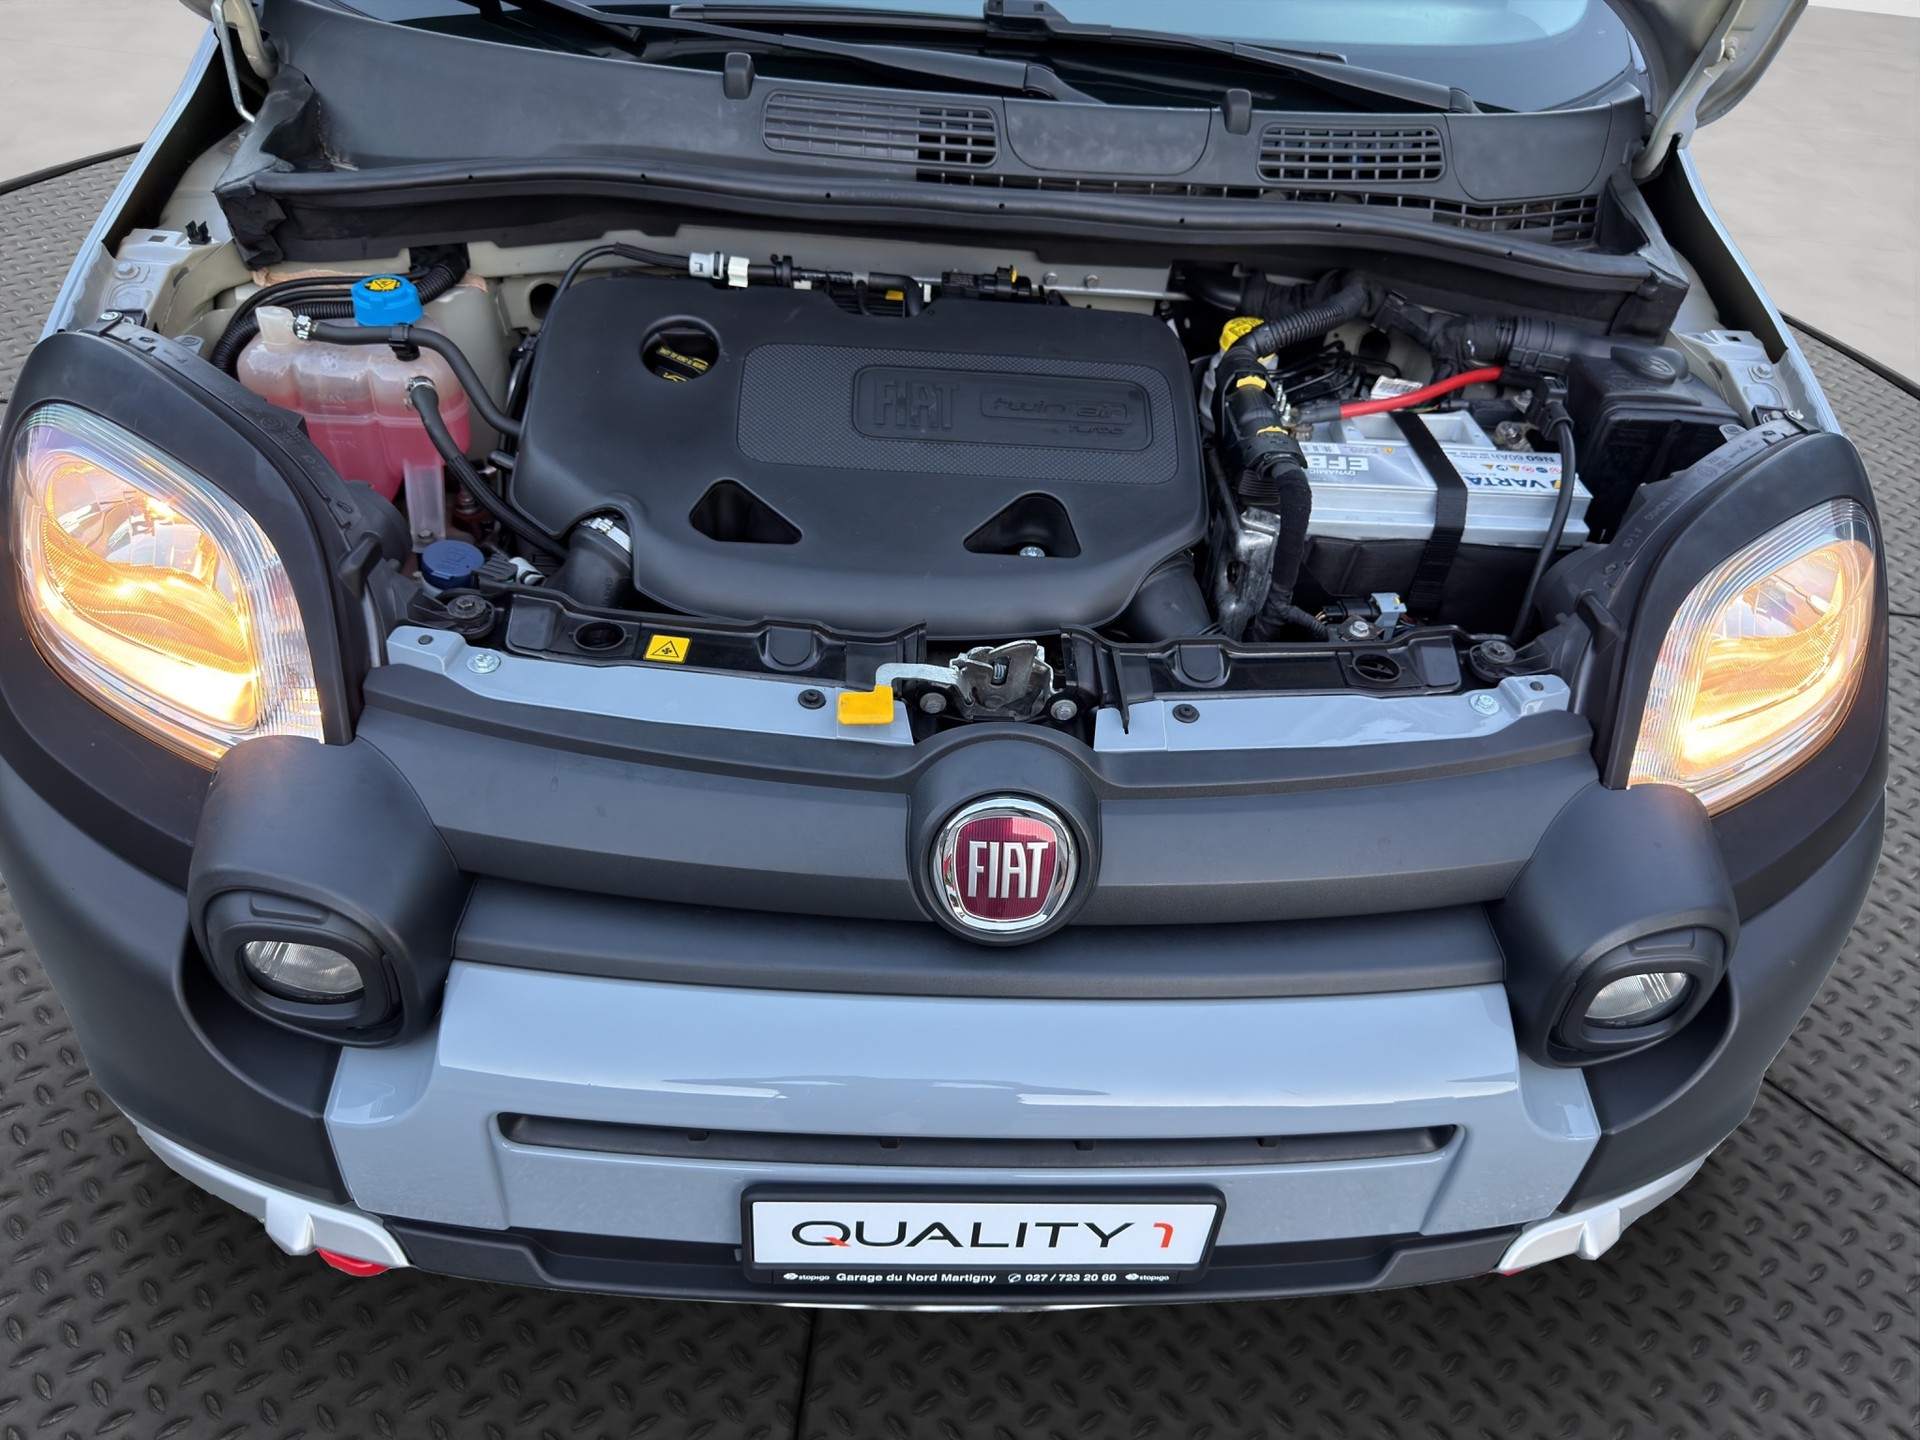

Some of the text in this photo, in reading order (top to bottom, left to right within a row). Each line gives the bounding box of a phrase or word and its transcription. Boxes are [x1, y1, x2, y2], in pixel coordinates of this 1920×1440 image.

[873, 379, 960, 429] FIAT
[1305, 455, 1369, 471] EFB
[1309, 468, 1356, 476] DYNAMIC
[1463, 475, 1548, 489] VARTA
[967, 840, 1049, 899] FIAT
[791, 1220, 1135, 1248] QUALITY
[835, 1272, 883, 1283] Garage
[886, 1272, 903, 1282] du
[906, 1272, 937, 1282] Nord
[941, 1273, 997, 1284] Martigny
[1025, 1273, 1048, 1282] 027
[1059, 1273, 1081, 1282] 723
[1083, 1273, 1099, 1282] 20
[1101, 1273, 1117, 1282] 60
